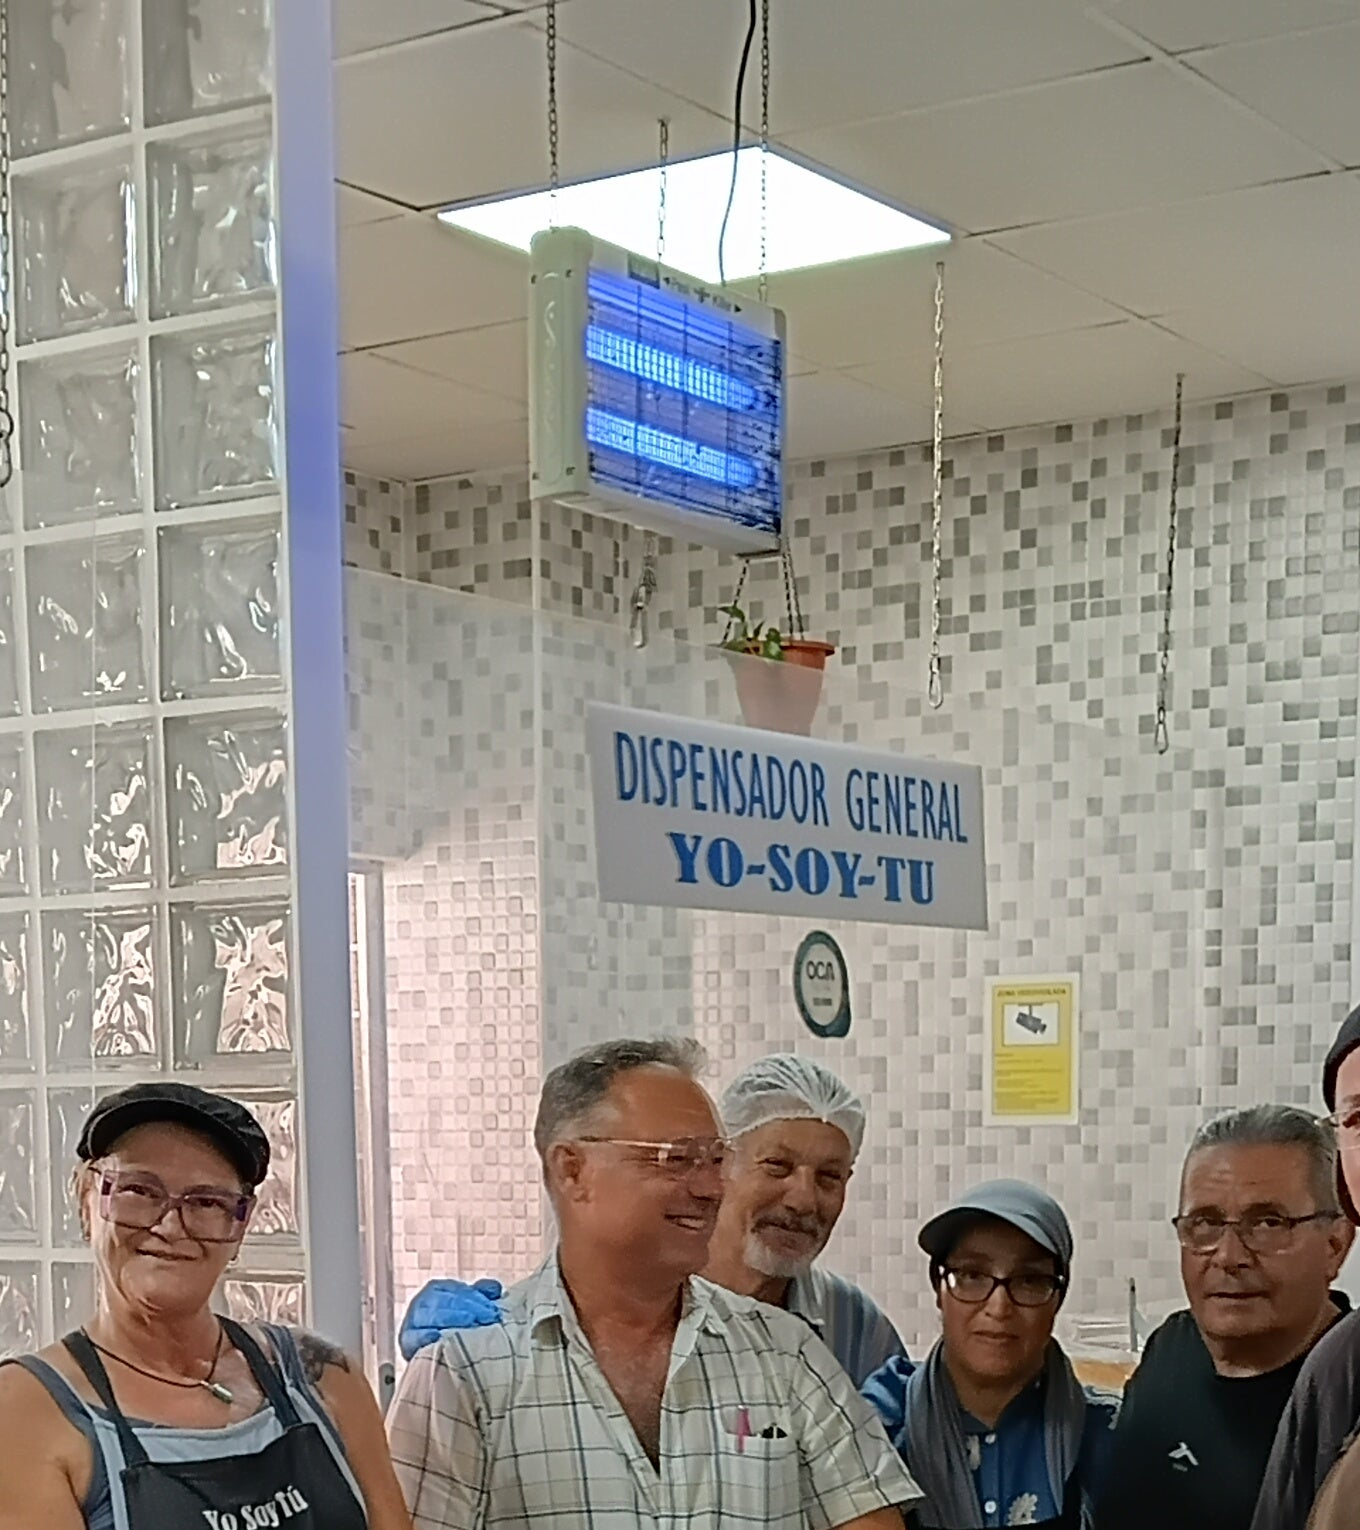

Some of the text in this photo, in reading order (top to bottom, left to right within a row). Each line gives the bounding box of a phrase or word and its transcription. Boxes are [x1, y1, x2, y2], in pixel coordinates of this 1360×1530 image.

[613, 730, 969, 844] DISPENSADOR GENERAL
[665, 831, 935, 905] YO-SOY-TU
[274, 1485, 309, 1518] Tú
